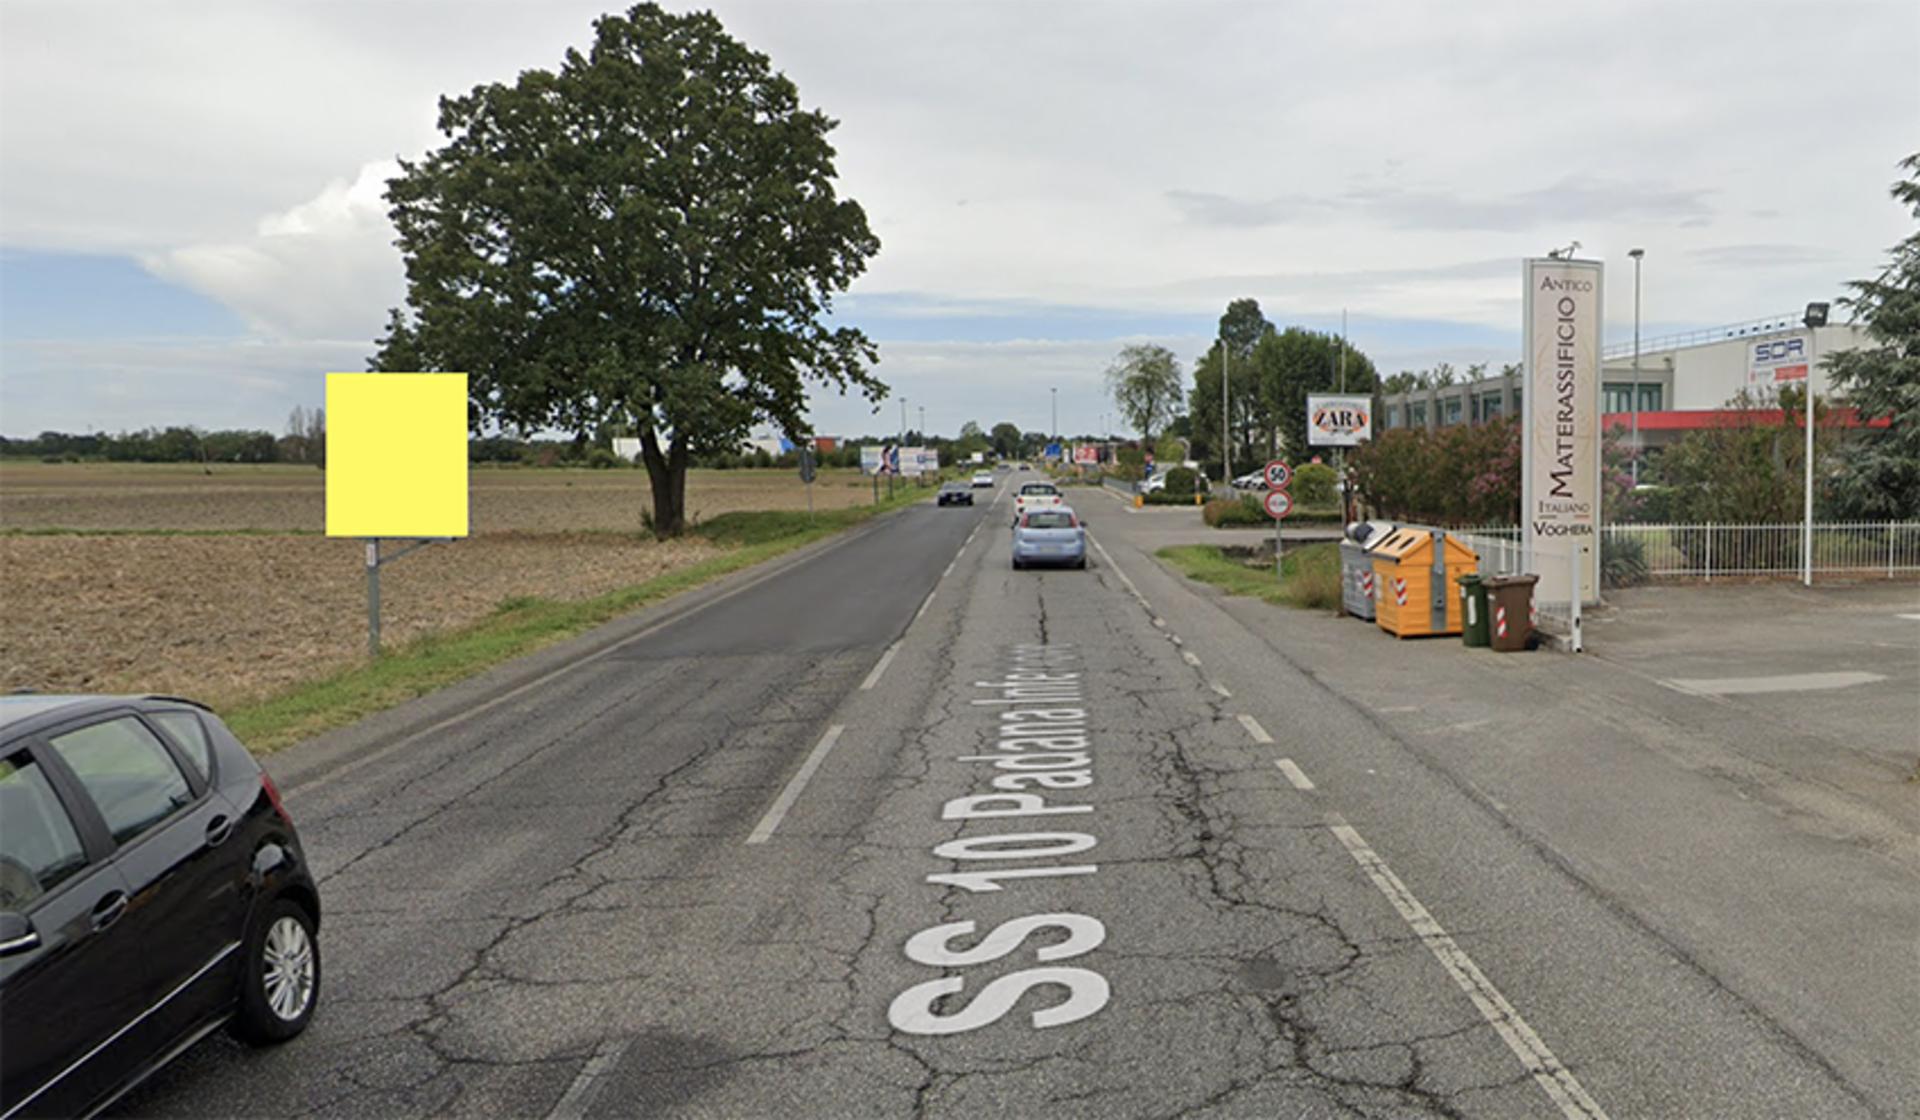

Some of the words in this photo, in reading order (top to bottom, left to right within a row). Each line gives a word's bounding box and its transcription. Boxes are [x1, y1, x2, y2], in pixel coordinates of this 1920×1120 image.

[1541, 276, 1593, 292] ANTICO
[1549, 296, 1576, 497] MATERASSIFICIO
[1314, 410, 1366, 427] ZARA
[1271, 467, 1286, 481] 50
[1539, 501, 1590, 513] ITALIANO
[1533, 522, 1593, 536] VOGHERA
